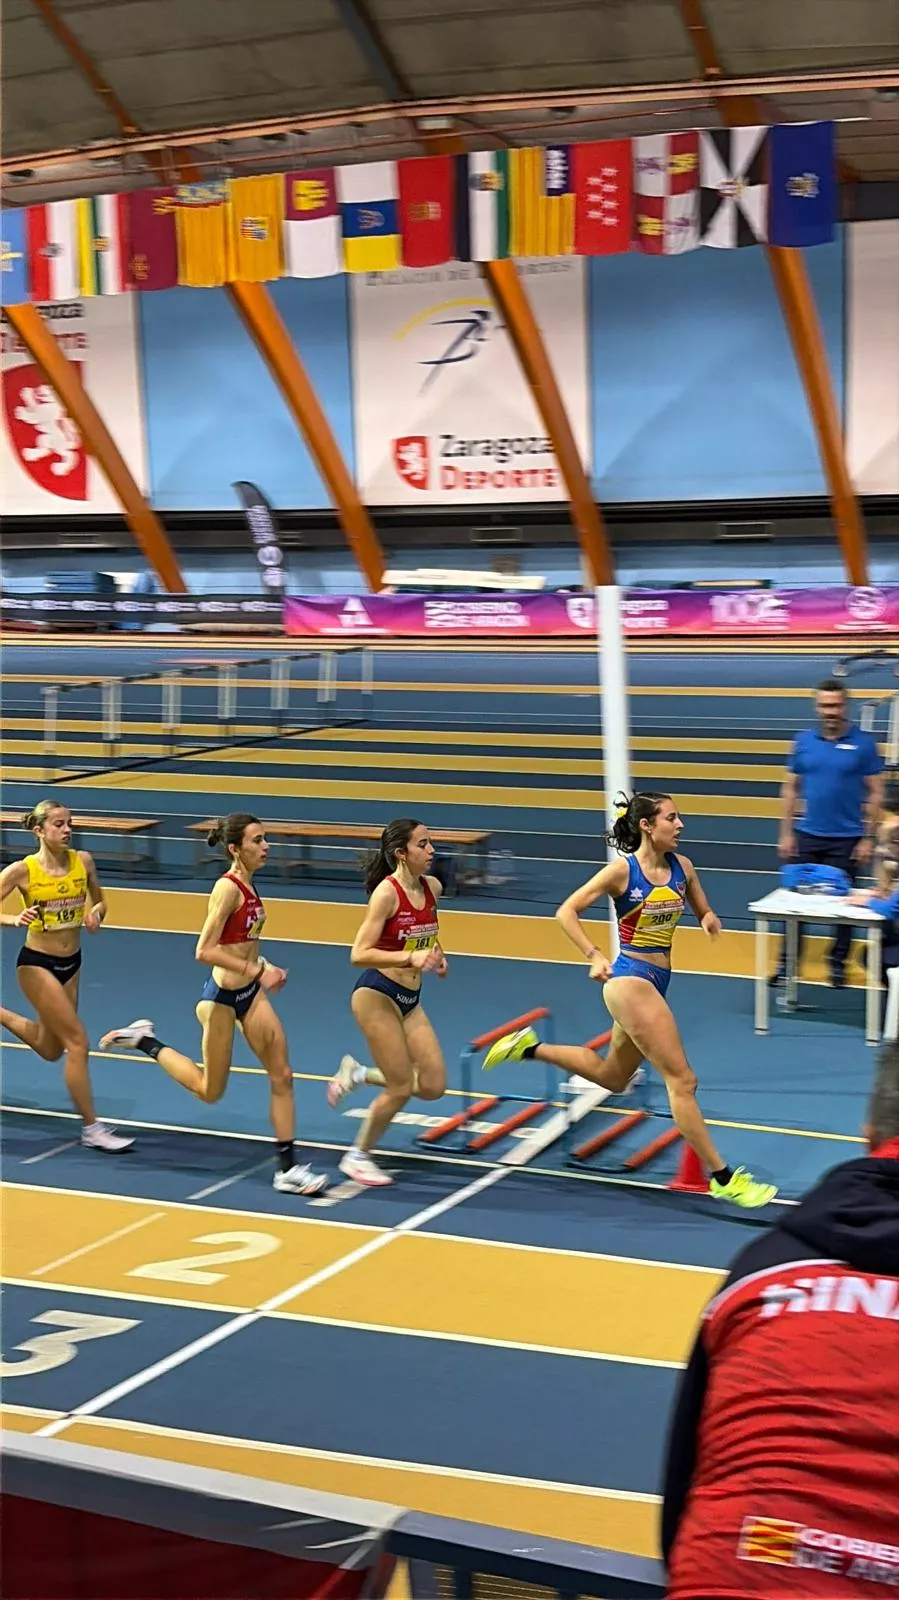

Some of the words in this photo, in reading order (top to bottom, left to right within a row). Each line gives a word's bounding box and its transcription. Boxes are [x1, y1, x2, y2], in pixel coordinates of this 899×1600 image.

[439, 433, 554, 463] Zaragoza
[440, 464, 562, 491] DEPORTE
[651, 913, 673, 925] 200
[125, 1231, 282, 1286] 2
[0, 1310, 143, 1377] 3
